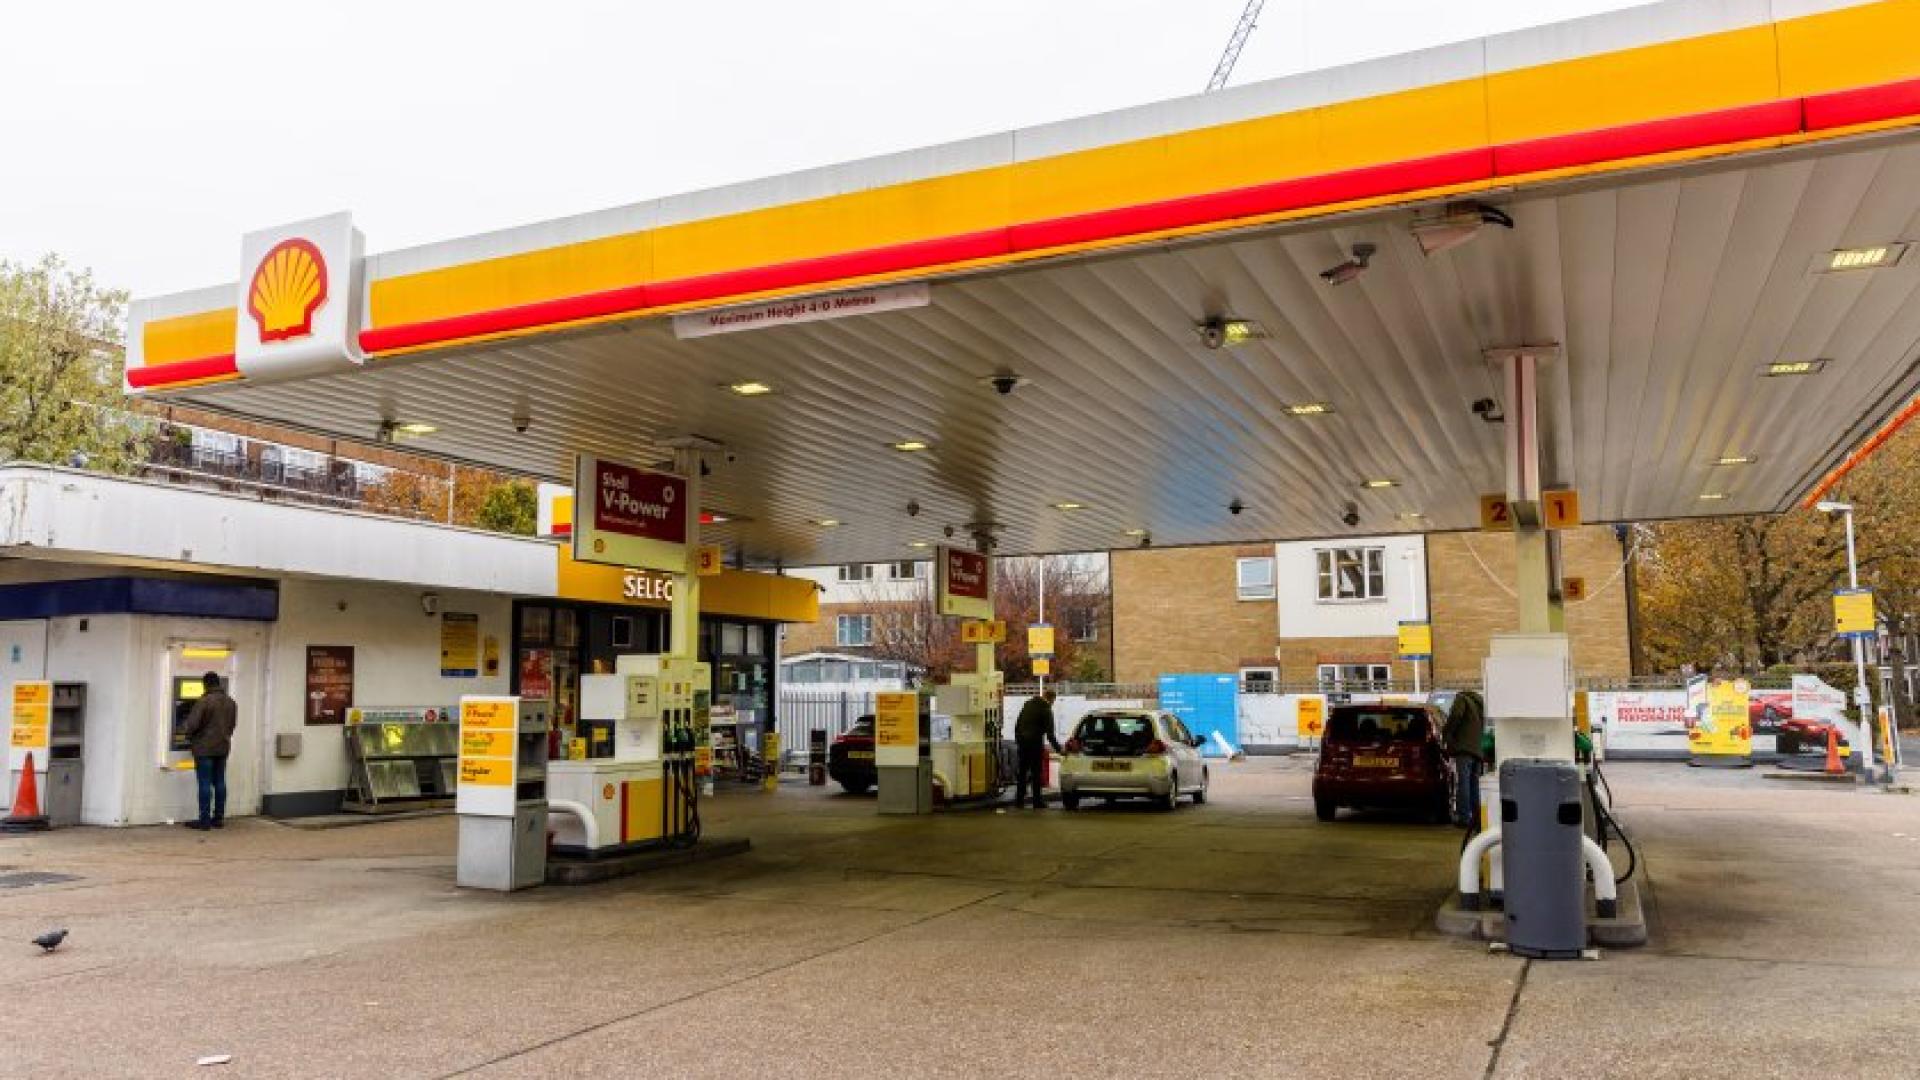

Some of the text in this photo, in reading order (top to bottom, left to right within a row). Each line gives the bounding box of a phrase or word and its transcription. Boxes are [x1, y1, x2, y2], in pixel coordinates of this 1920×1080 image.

[710, 311, 764, 326] Maximum
[767, 302, 806, 319] Height
[834, 295, 876, 309] Metres
[602, 472, 630, 490] Shell
[602, 488, 670, 520] V-Power
[1491, 501, 1507, 521] 2
[1553, 499, 1564, 521] 1
[700, 552, 712, 568] 3
[623, 574, 673, 601] SELEC
[1568, 582, 1578, 597] 5
